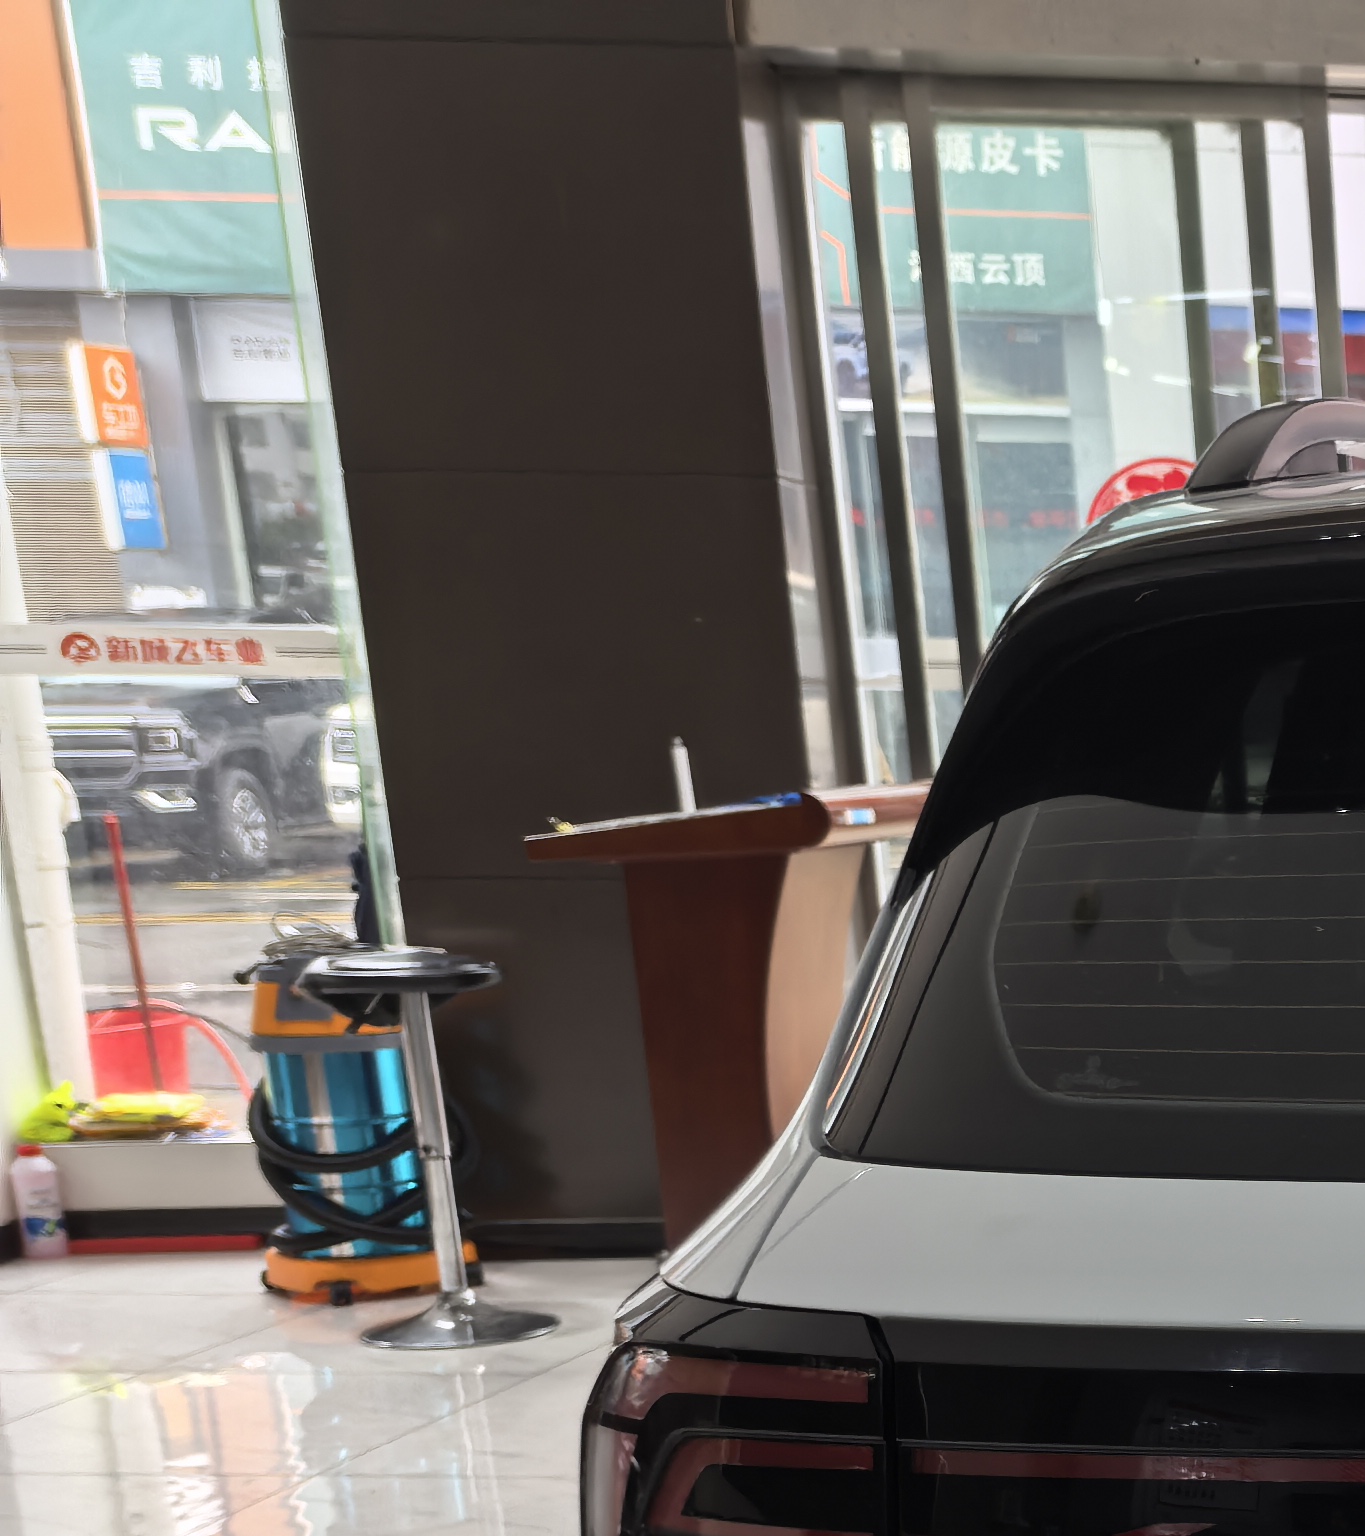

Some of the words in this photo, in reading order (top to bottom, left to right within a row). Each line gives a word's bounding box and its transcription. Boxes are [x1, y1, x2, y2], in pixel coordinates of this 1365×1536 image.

[104, 636, 266, 666] 新城飞车业
